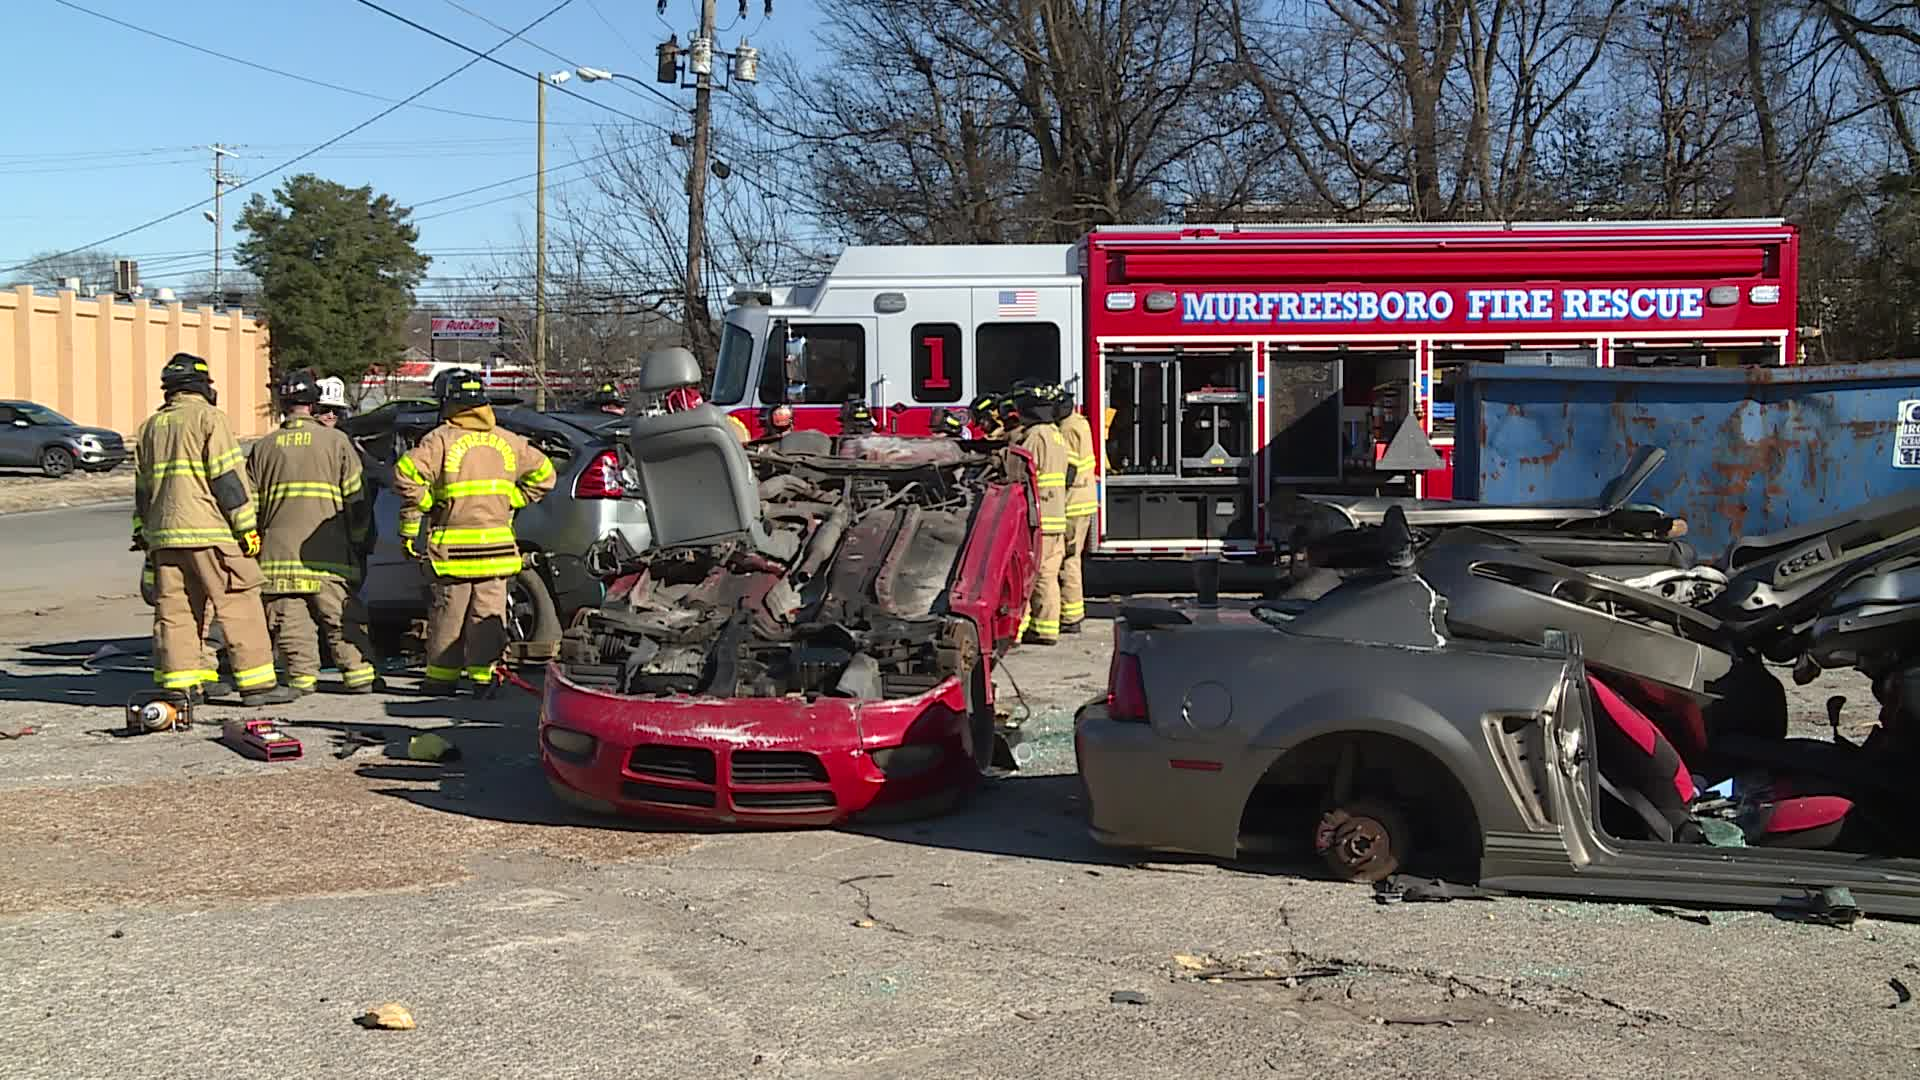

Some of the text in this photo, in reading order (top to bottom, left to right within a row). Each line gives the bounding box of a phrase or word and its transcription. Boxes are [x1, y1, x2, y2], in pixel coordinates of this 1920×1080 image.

[1181, 287, 1704, 323] MURFREESBORO FIRE RESCUE
[446, 318, 496, 330] AutoZone
[923, 336, 951, 389] 1
[275, 431, 313, 448] MFRD
